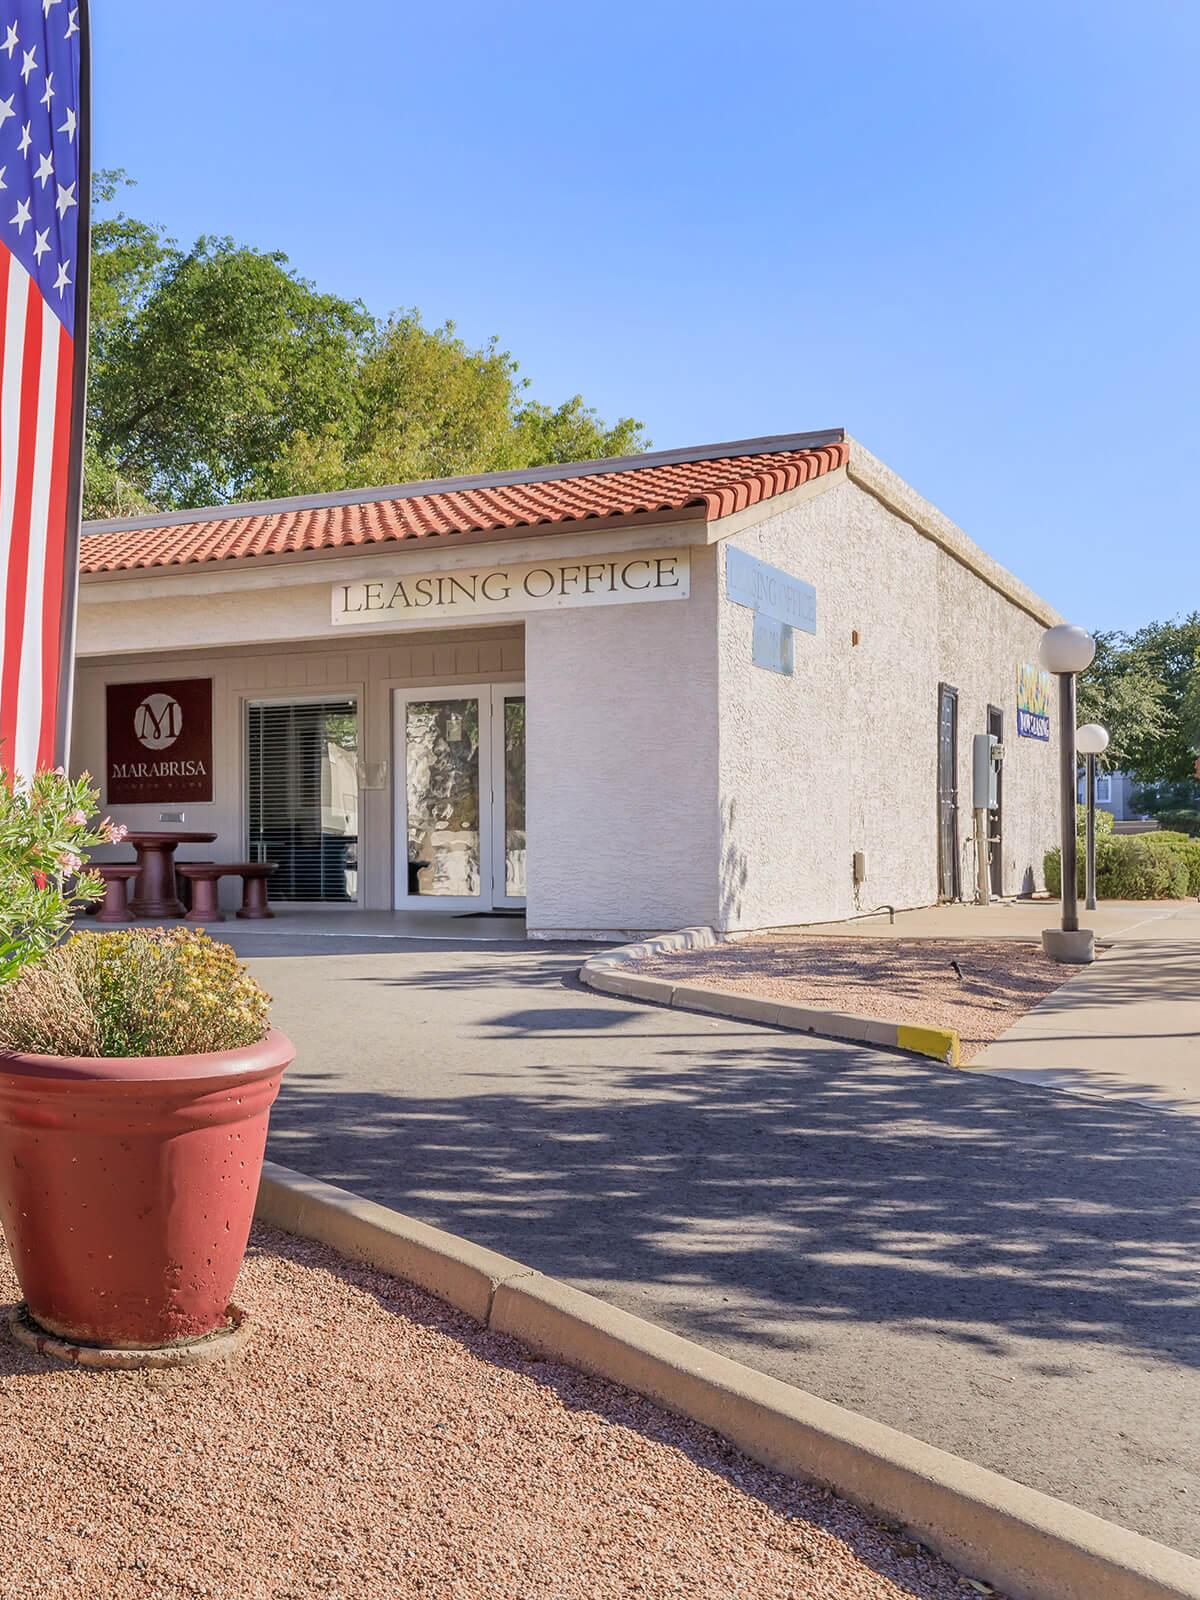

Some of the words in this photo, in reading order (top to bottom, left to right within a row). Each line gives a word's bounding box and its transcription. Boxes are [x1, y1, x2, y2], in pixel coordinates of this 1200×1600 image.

[341, 572, 512, 614] LEASING
[523, 557, 680, 601] OFFICE
[729, 560, 777, 607] LSING
[111, 760, 207, 779] MARABRISA
